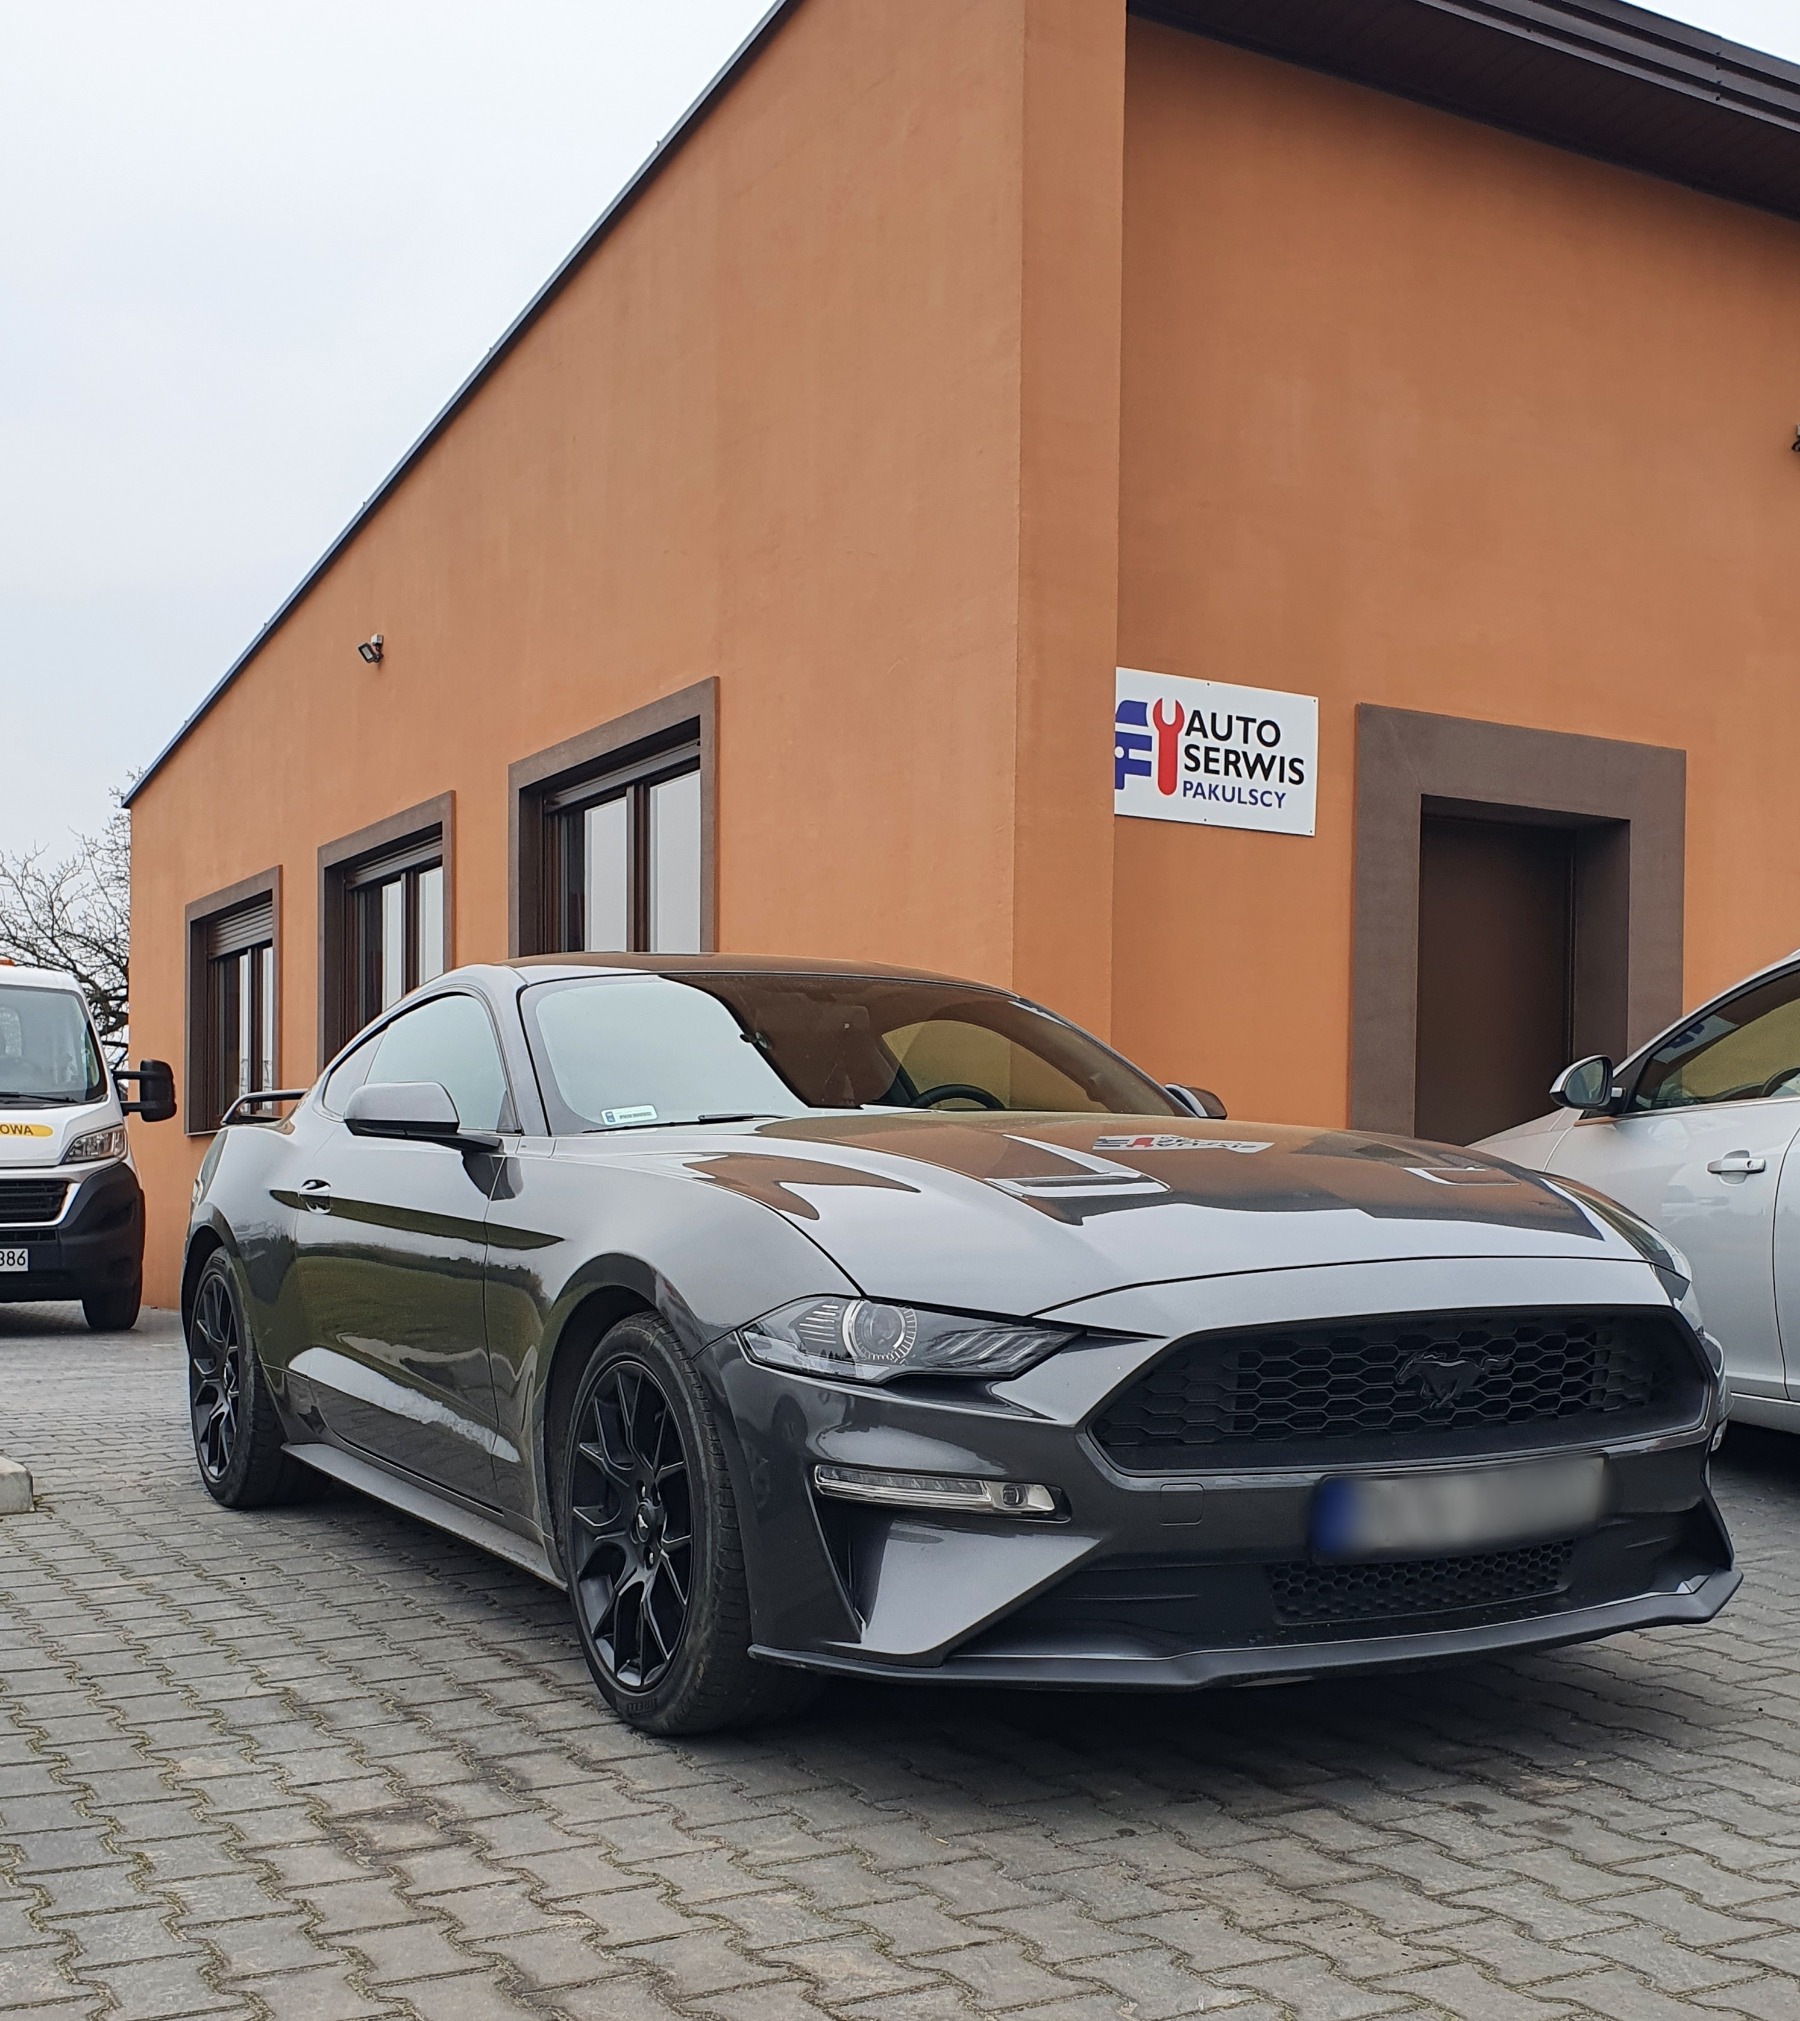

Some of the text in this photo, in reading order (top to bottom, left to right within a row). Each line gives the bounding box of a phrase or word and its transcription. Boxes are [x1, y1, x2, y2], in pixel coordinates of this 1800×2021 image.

[1184, 709, 1281, 748] AUTO
[1183, 743, 1305, 786] SERWIS
[1182, 780, 1287, 809] PAKULSCY
